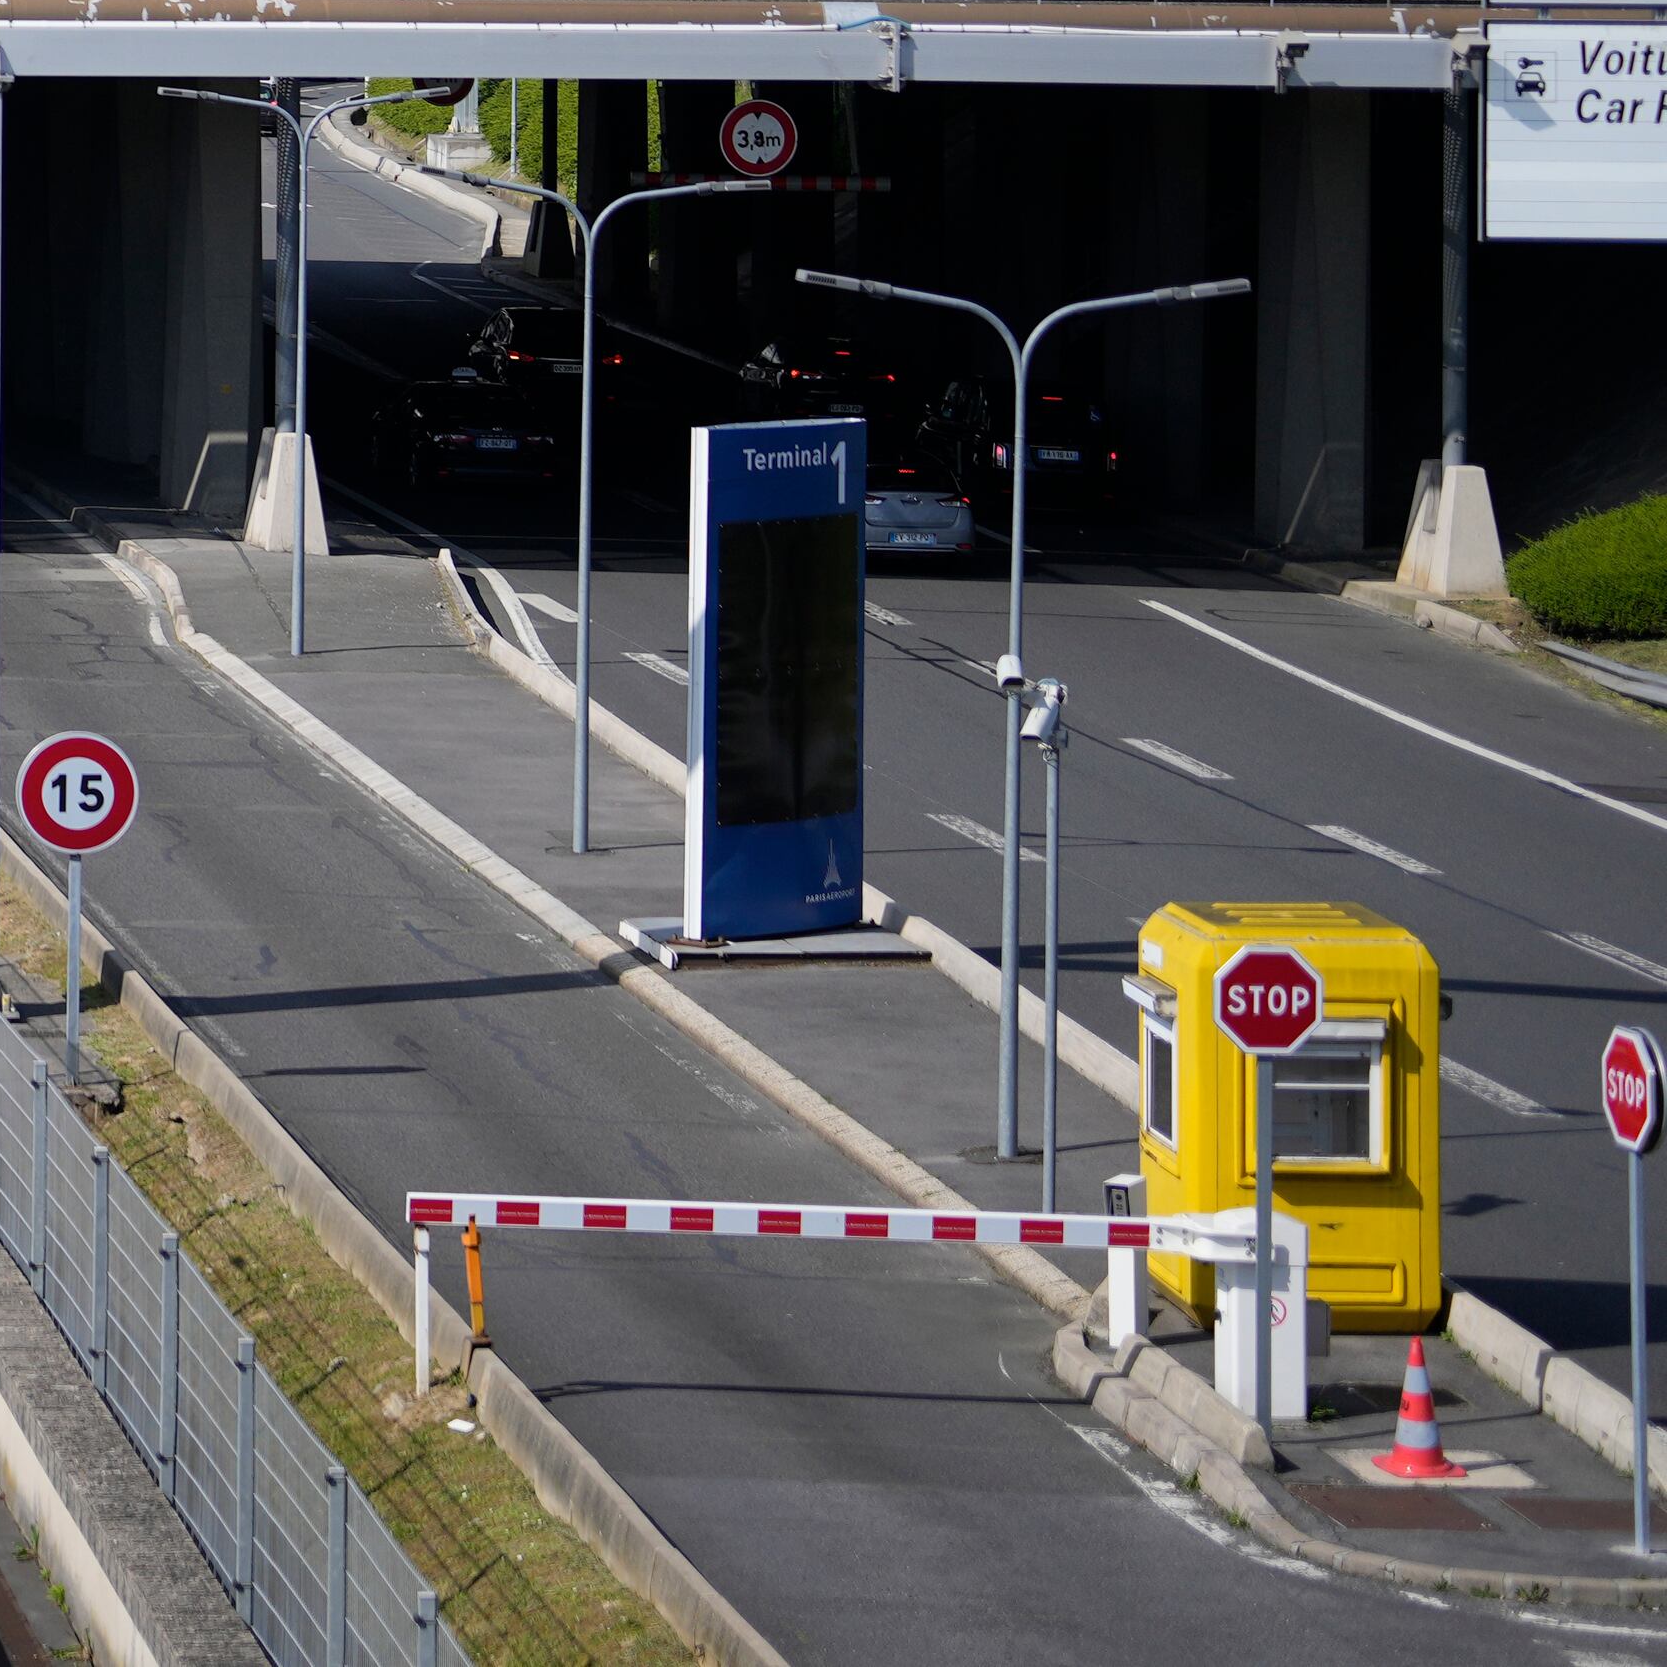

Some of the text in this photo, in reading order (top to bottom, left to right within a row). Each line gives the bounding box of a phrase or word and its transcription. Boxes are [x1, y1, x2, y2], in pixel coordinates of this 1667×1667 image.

[1576, 88, 1643, 123] Car
[742, 440, 846, 505] Terminal 1
[51, 774, 104, 812] 15
[1227, 984, 1310, 1016] STOP
[1607, 1068, 1645, 1109] STOP
